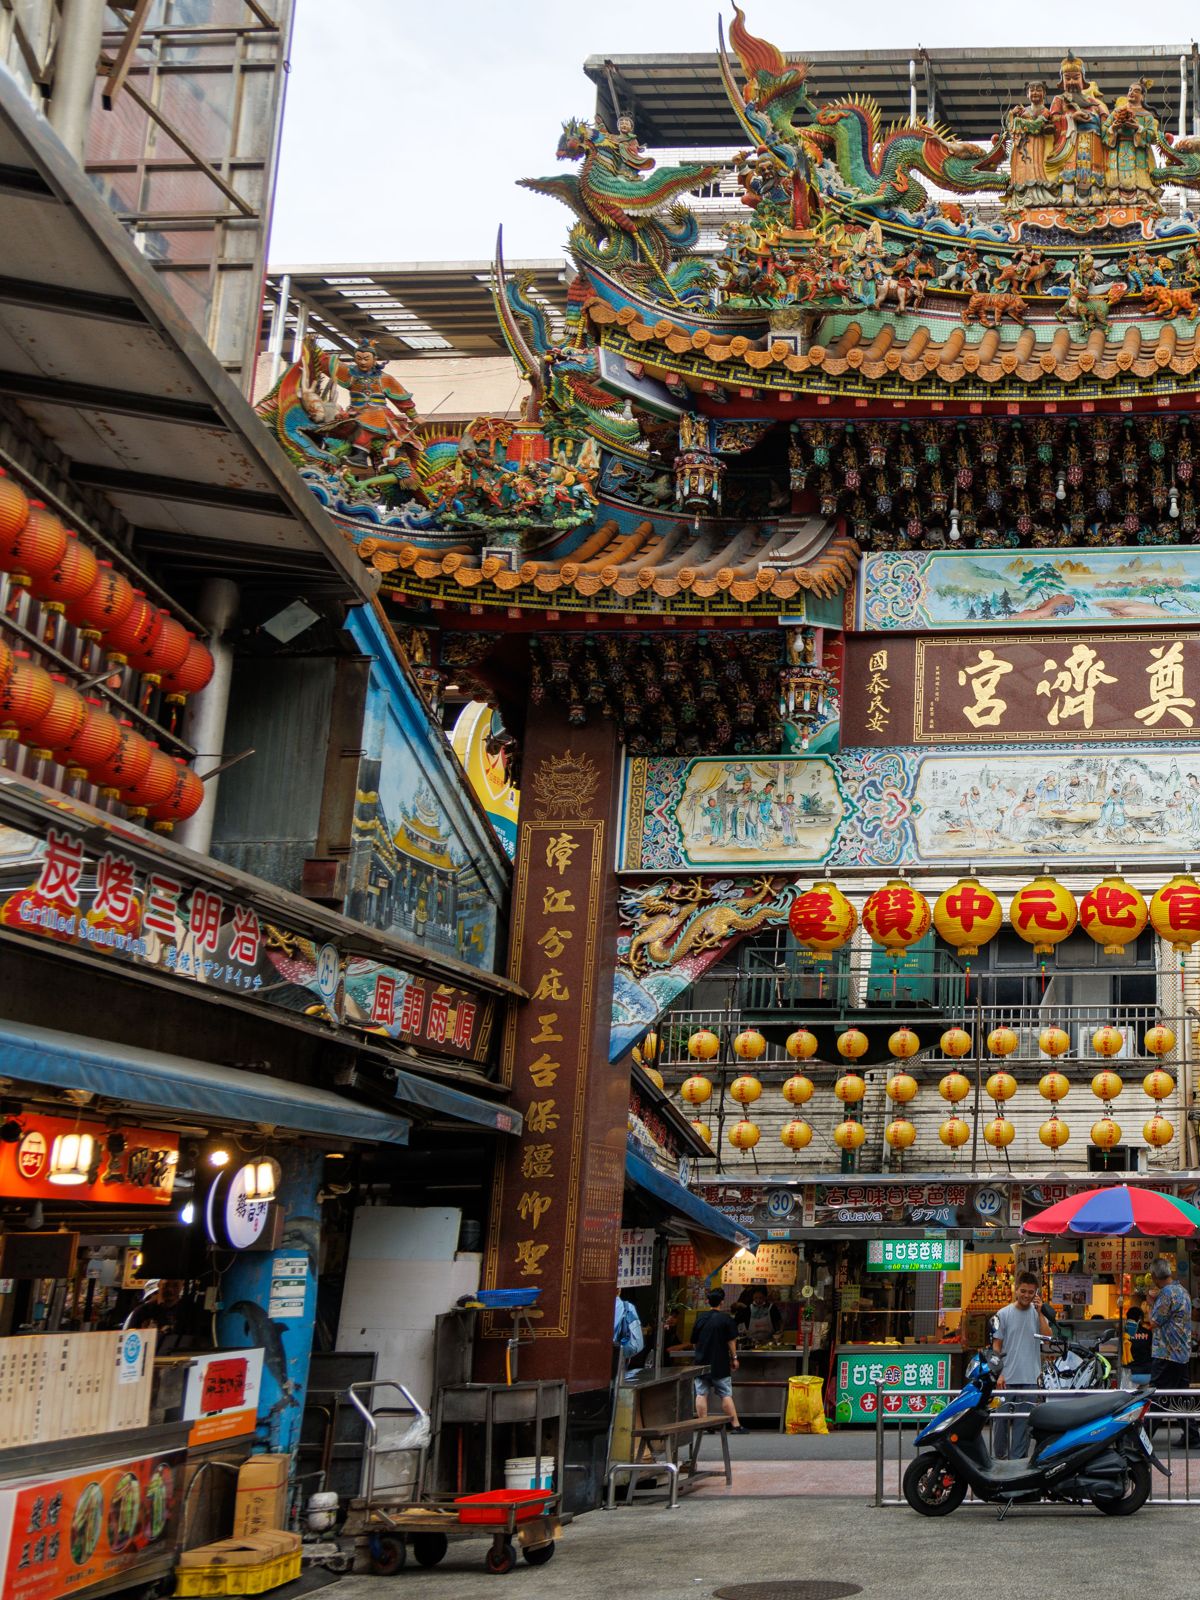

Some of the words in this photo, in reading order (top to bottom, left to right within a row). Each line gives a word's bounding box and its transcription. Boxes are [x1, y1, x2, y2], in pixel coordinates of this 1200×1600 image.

[864, 649, 891, 733] 國泰民安
[958, 640, 1196, 730] 奠濟宮
[37, 828, 262, 967] 炭烤三明治
[19, 898, 76, 937] Grilled
[79, 917, 149, 957] Sandwich
[370, 974, 478, 1051] 風調雨順
[511, 832, 580, 1319] 漳江分庇三台保疆仰聖
[772, 1194, 790, 1212] 30
[826, 1186, 967, 1208] 古早味甘草芭樂
[980, 1193, 996, 1211] 32
[838, 1209, 883, 1222] Guava
[895, 1242, 943, 1260] 甘草芭樂
[1143, 1251, 1154, 1260] 80
[853, 1363, 884, 1386] 甘草
[904, 1363, 934, 1386] 芭樂
